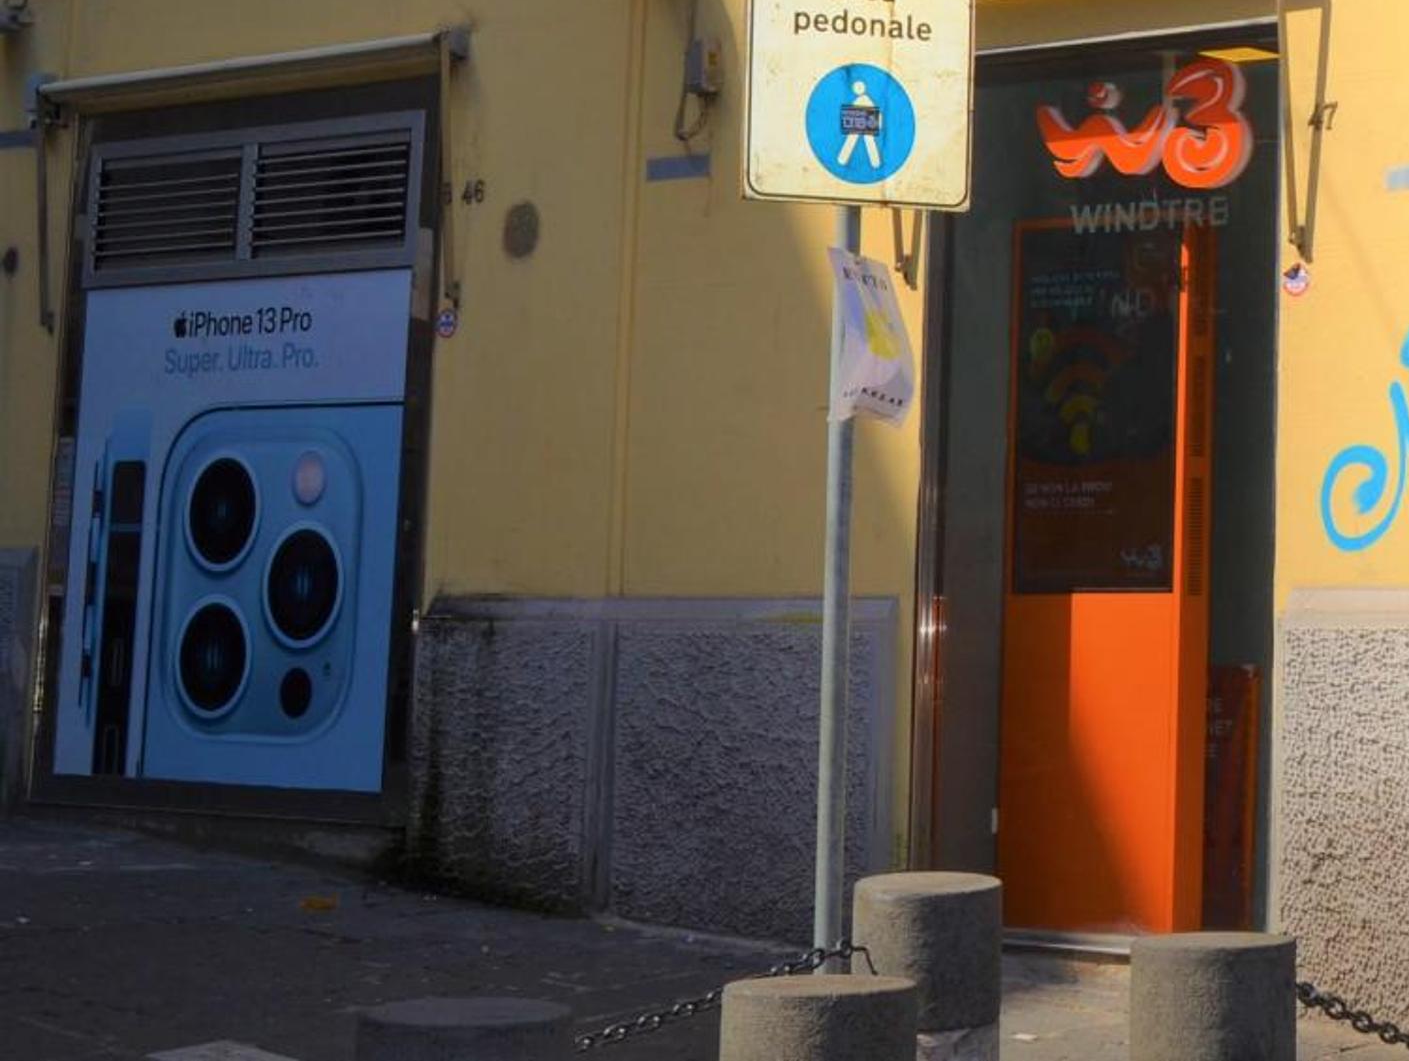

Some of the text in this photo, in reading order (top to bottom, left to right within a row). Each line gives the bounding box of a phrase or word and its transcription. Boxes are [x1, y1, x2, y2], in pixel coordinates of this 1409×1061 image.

[793, 8, 933, 42] pedonale
[461, 179, 486, 206] 46
[188, 306, 313, 339] iPhone 13 Pro
[164, 341, 319, 377] Super. Ultra. Pro.
